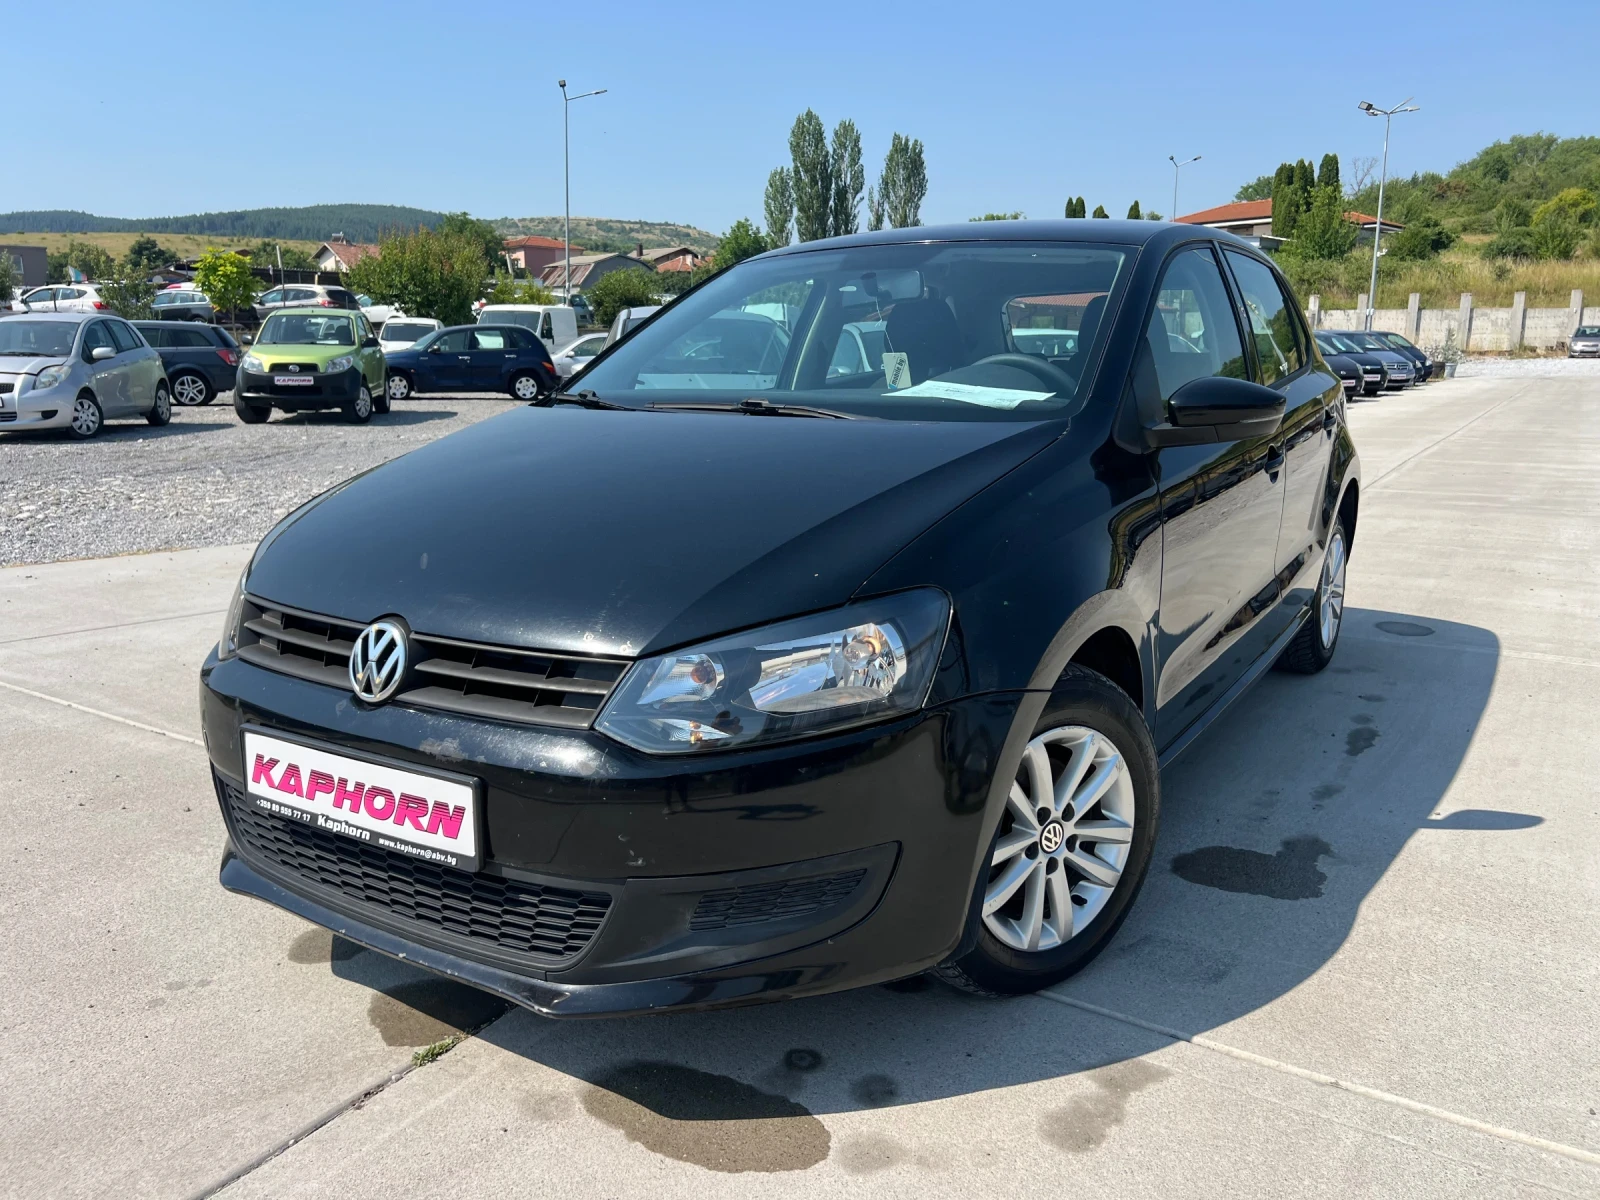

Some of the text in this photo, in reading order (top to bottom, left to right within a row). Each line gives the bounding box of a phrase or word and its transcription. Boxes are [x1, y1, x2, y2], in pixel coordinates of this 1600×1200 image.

[252, 753, 466, 839] KAPHORN
[293, 810, 302, 819] 77
[302, 813, 311, 822] 17
[317, 814, 370, 840] Kaphorn
[378, 838, 457, 865] www.kaphorn@abv.bg
